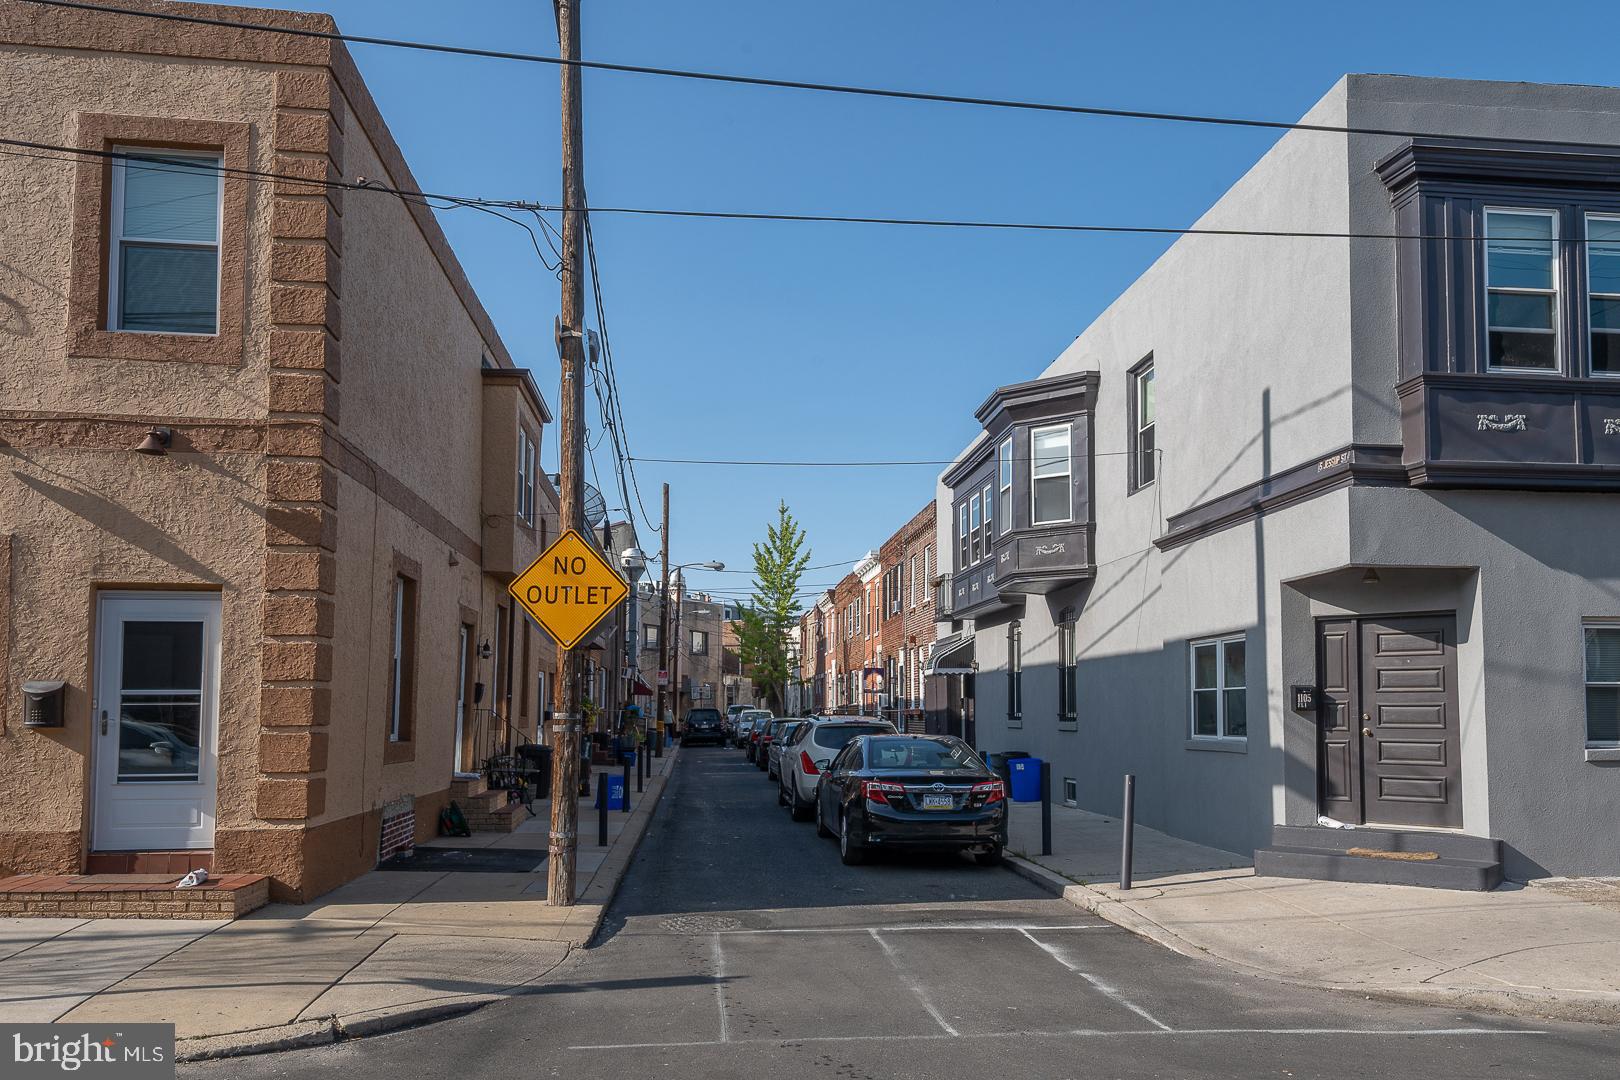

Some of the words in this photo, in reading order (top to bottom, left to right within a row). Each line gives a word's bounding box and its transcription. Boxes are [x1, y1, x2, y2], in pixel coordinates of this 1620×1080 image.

[554, 556, 586, 575] NO
[526, 585, 612, 605] OUTLET
[1297, 693, 1312, 703] 1105
